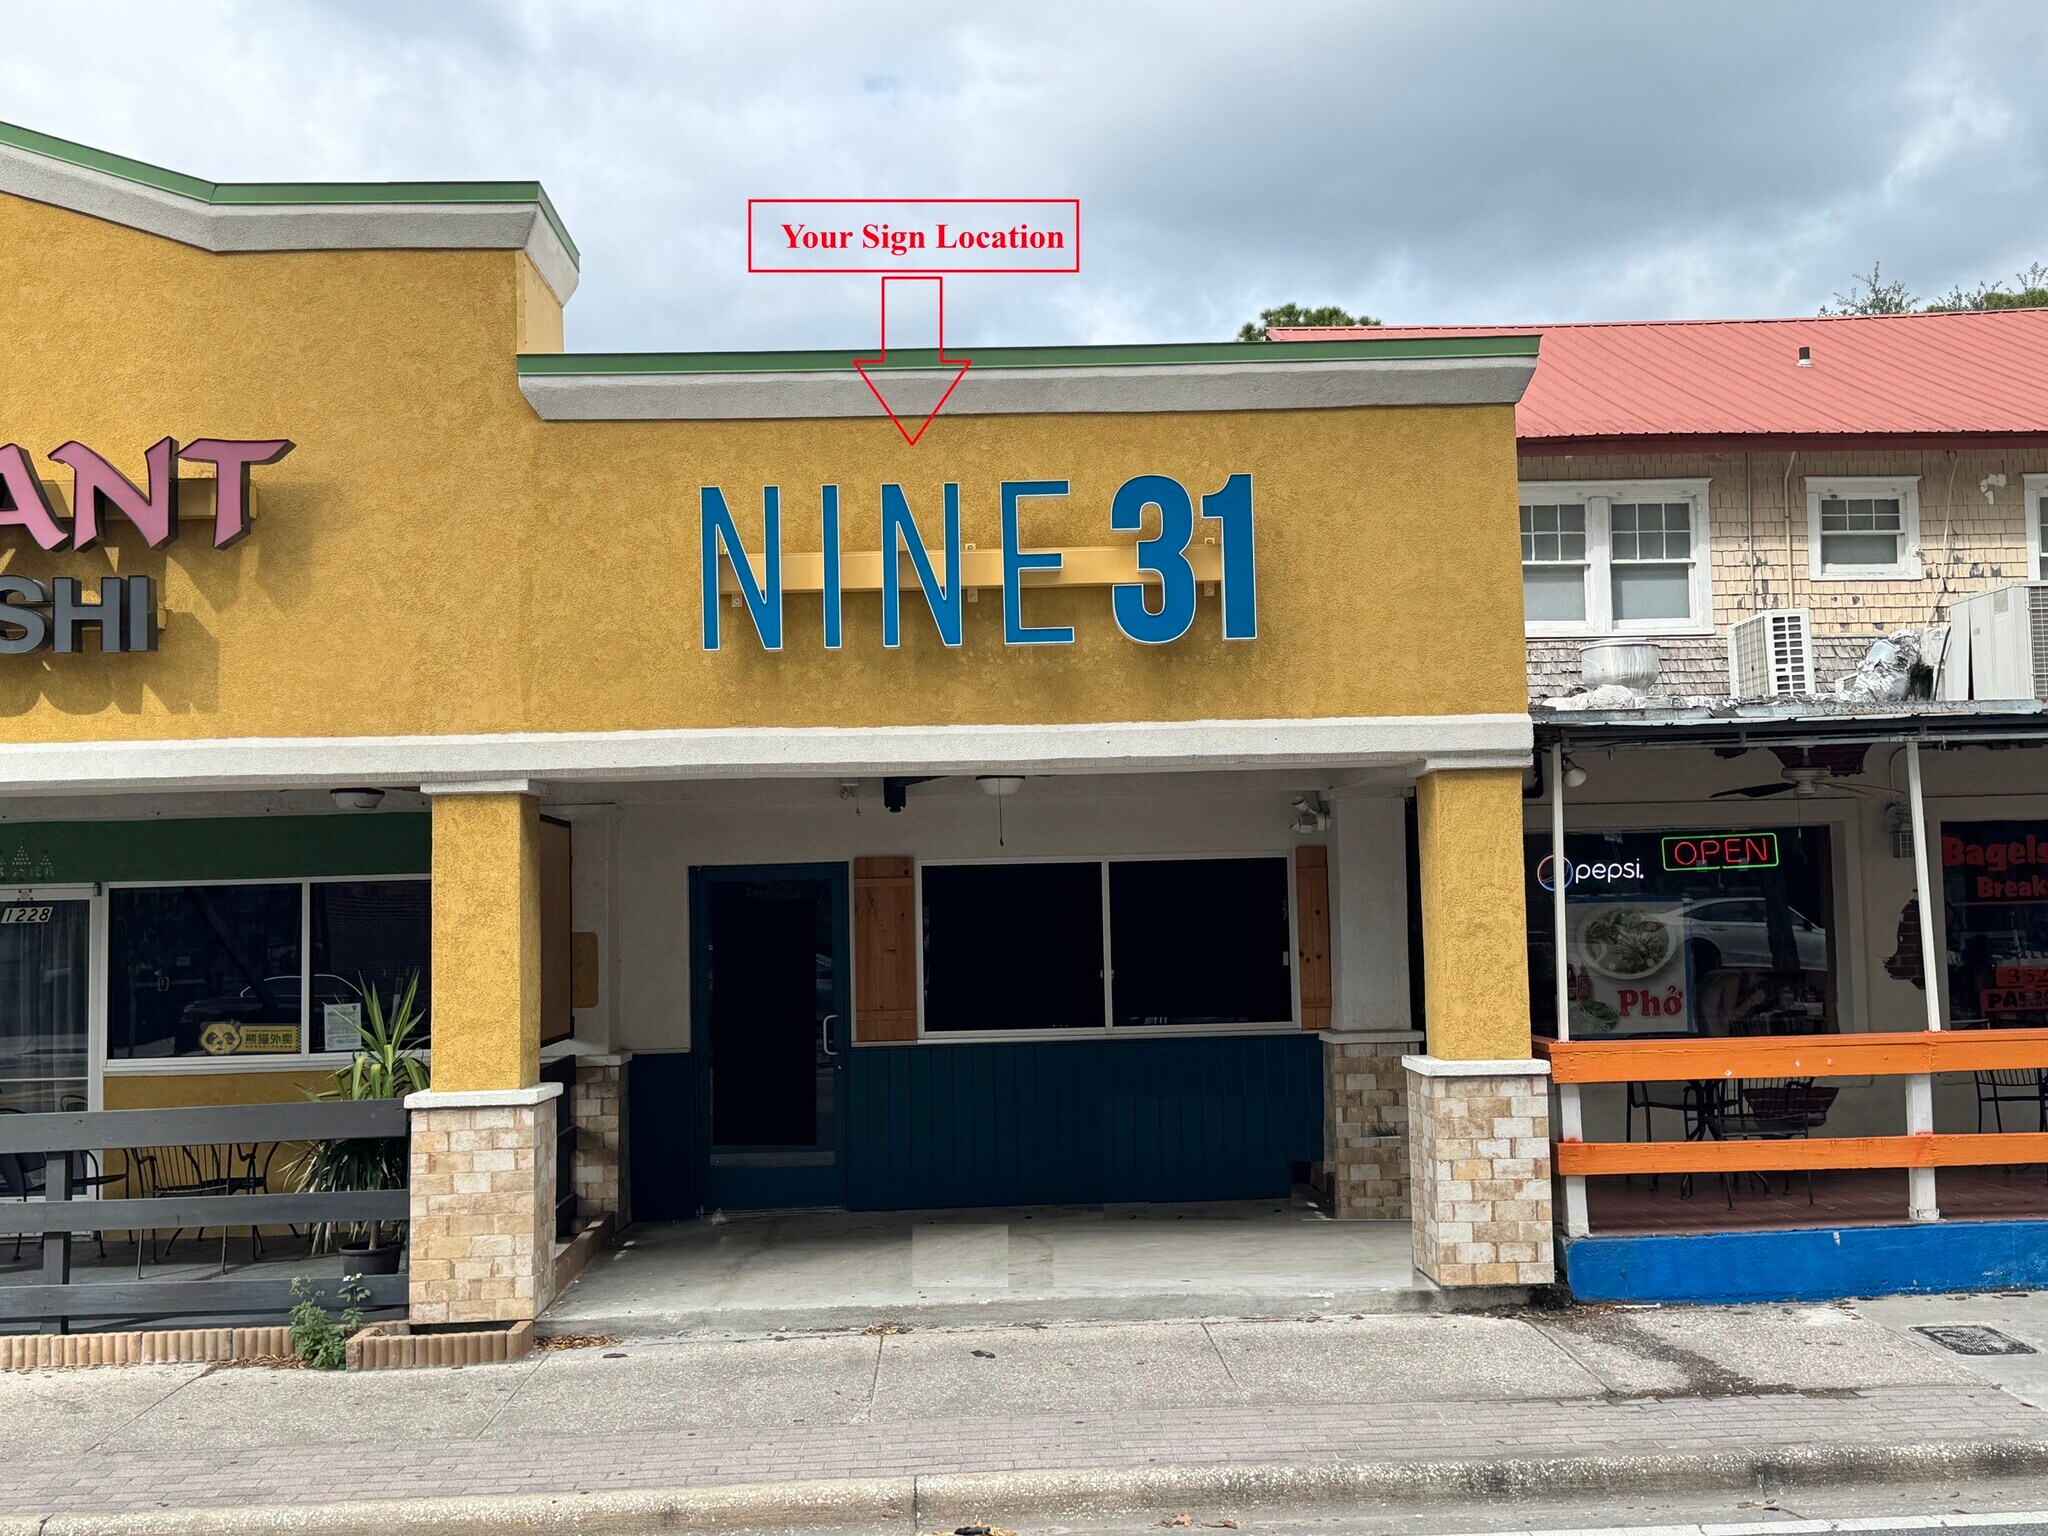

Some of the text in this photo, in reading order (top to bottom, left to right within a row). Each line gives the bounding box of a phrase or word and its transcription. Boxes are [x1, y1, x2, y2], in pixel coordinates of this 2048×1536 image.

[700, 472, 1258, 651] NINE 31
[1674, 838, 1767, 866] OPEN
[1977, 875, 2048, 898] Break
[6, 908, 51, 922] 1228
[1617, 985, 1684, 1017] Phở
